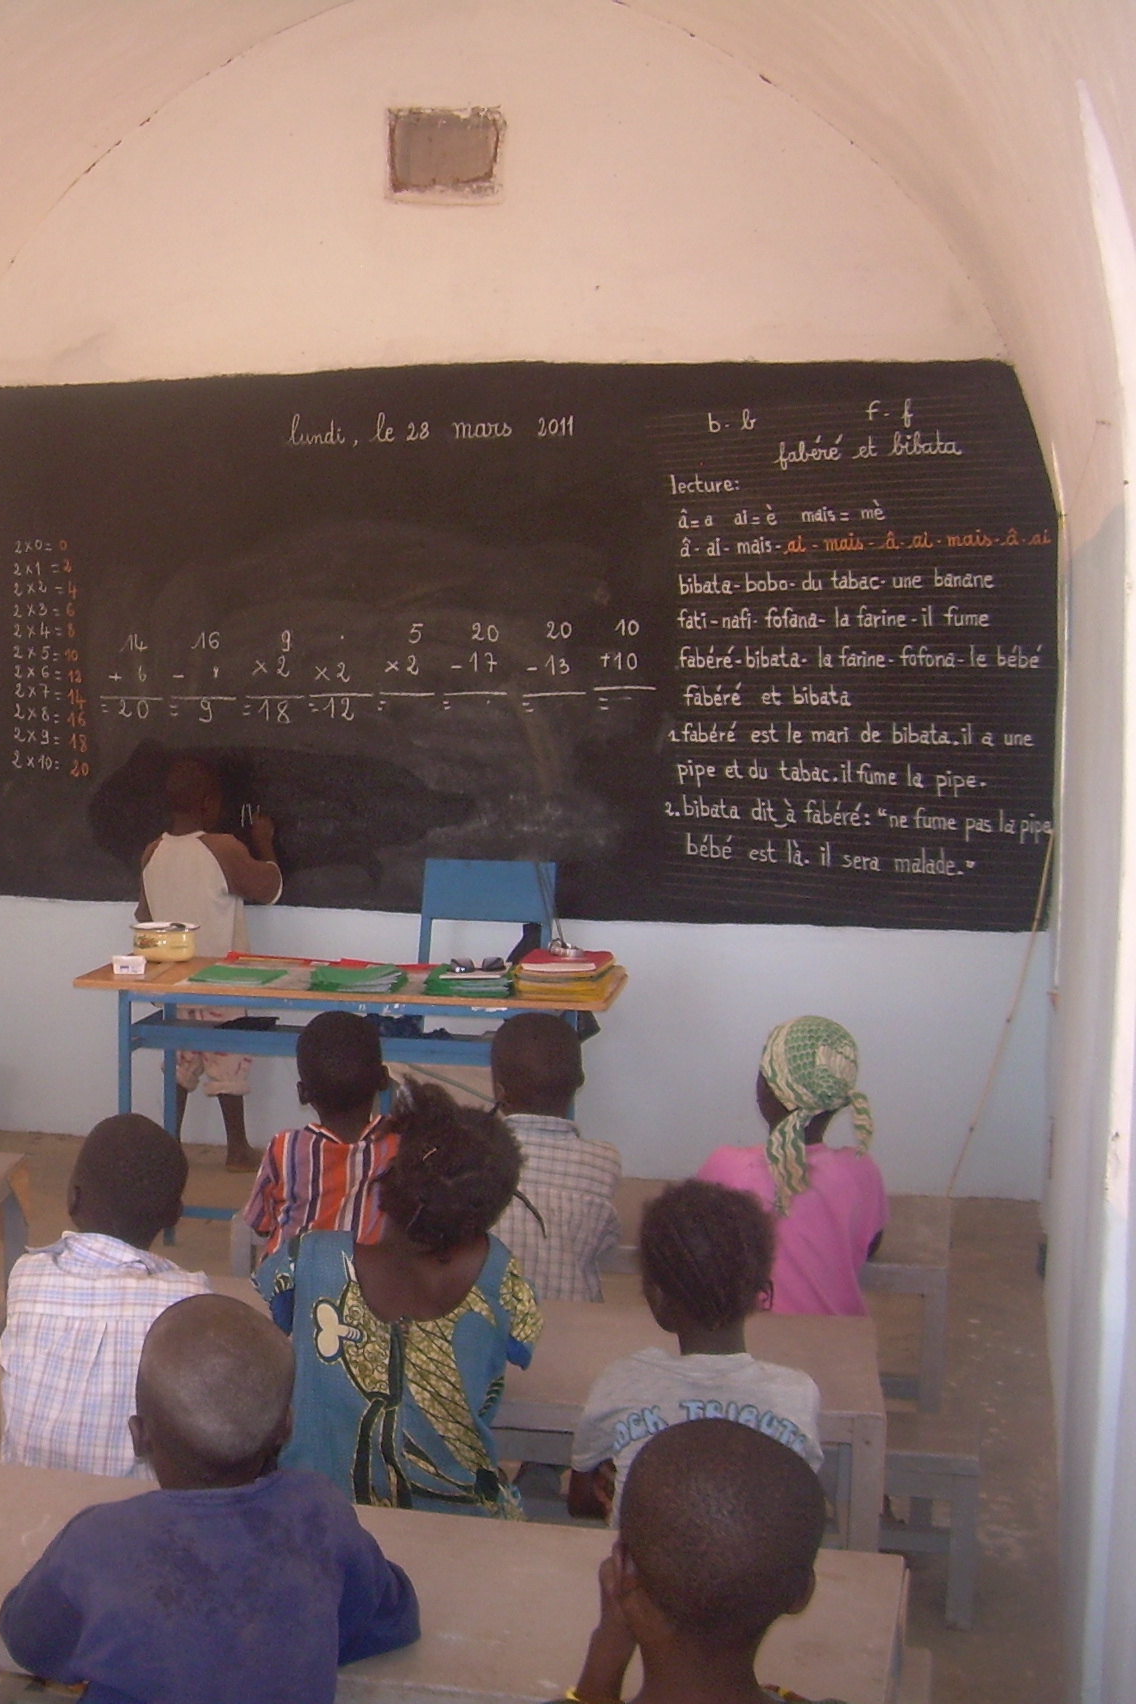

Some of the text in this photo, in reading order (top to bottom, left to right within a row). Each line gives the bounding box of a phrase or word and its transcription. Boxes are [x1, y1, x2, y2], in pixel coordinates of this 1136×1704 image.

[370, 412, 395, 443] le
[406, 421, 430, 442] 28
[451, 420, 513, 438] mars
[537, 414, 574, 437] 2011
[741, 408, 757, 430] b
[773, 429, 963, 470] fabéré et bibata
[670, 473, 740, 494] lecture:
[861, 499, 886, 521] mè
[802, 570, 823, 592] du
[892, 575, 923, 589] une
[934, 567, 995, 589] banane
[835, 606, 851, 628] la
[921, 605, 933, 627] il
[943, 605, 990, 628] fume
[120, 619, 639, 652] 14 16 9 5 20 20 10
[819, 645, 833, 669] la
[970, 645, 988, 668] le
[997, 644, 1043, 669] bébé
[683, 682, 852, 707] fabéré et bibata
[751, 722, 779, 743] est
[787, 721, 804, 743] le
[812, 726, 850, 743] mari
[860, 722, 882, 743] de
[981, 732, 995, 747] a
[1004, 733, 1035, 747] une
[676, 759, 716, 788] pipe
[725, 758, 744, 779] et
[749, 758, 768, 780] du
[841, 760, 851, 783] il
[856, 763, 898, 786] fume
[907, 763, 924, 789] la
[936, 770, 987, 798] pipe.
[682, 794, 741, 820] bibata
[751, 797, 777, 822] dit
[783, 797, 797, 823] à
[913, 807, 959, 831] fume
[965, 817, 994, 842] pas
[999, 808, 1016, 835] la
[685, 832, 732, 860] bébé
[749, 839, 777, 863] est
[820, 841, 831, 868] il
[842, 853, 881, 872] sera
